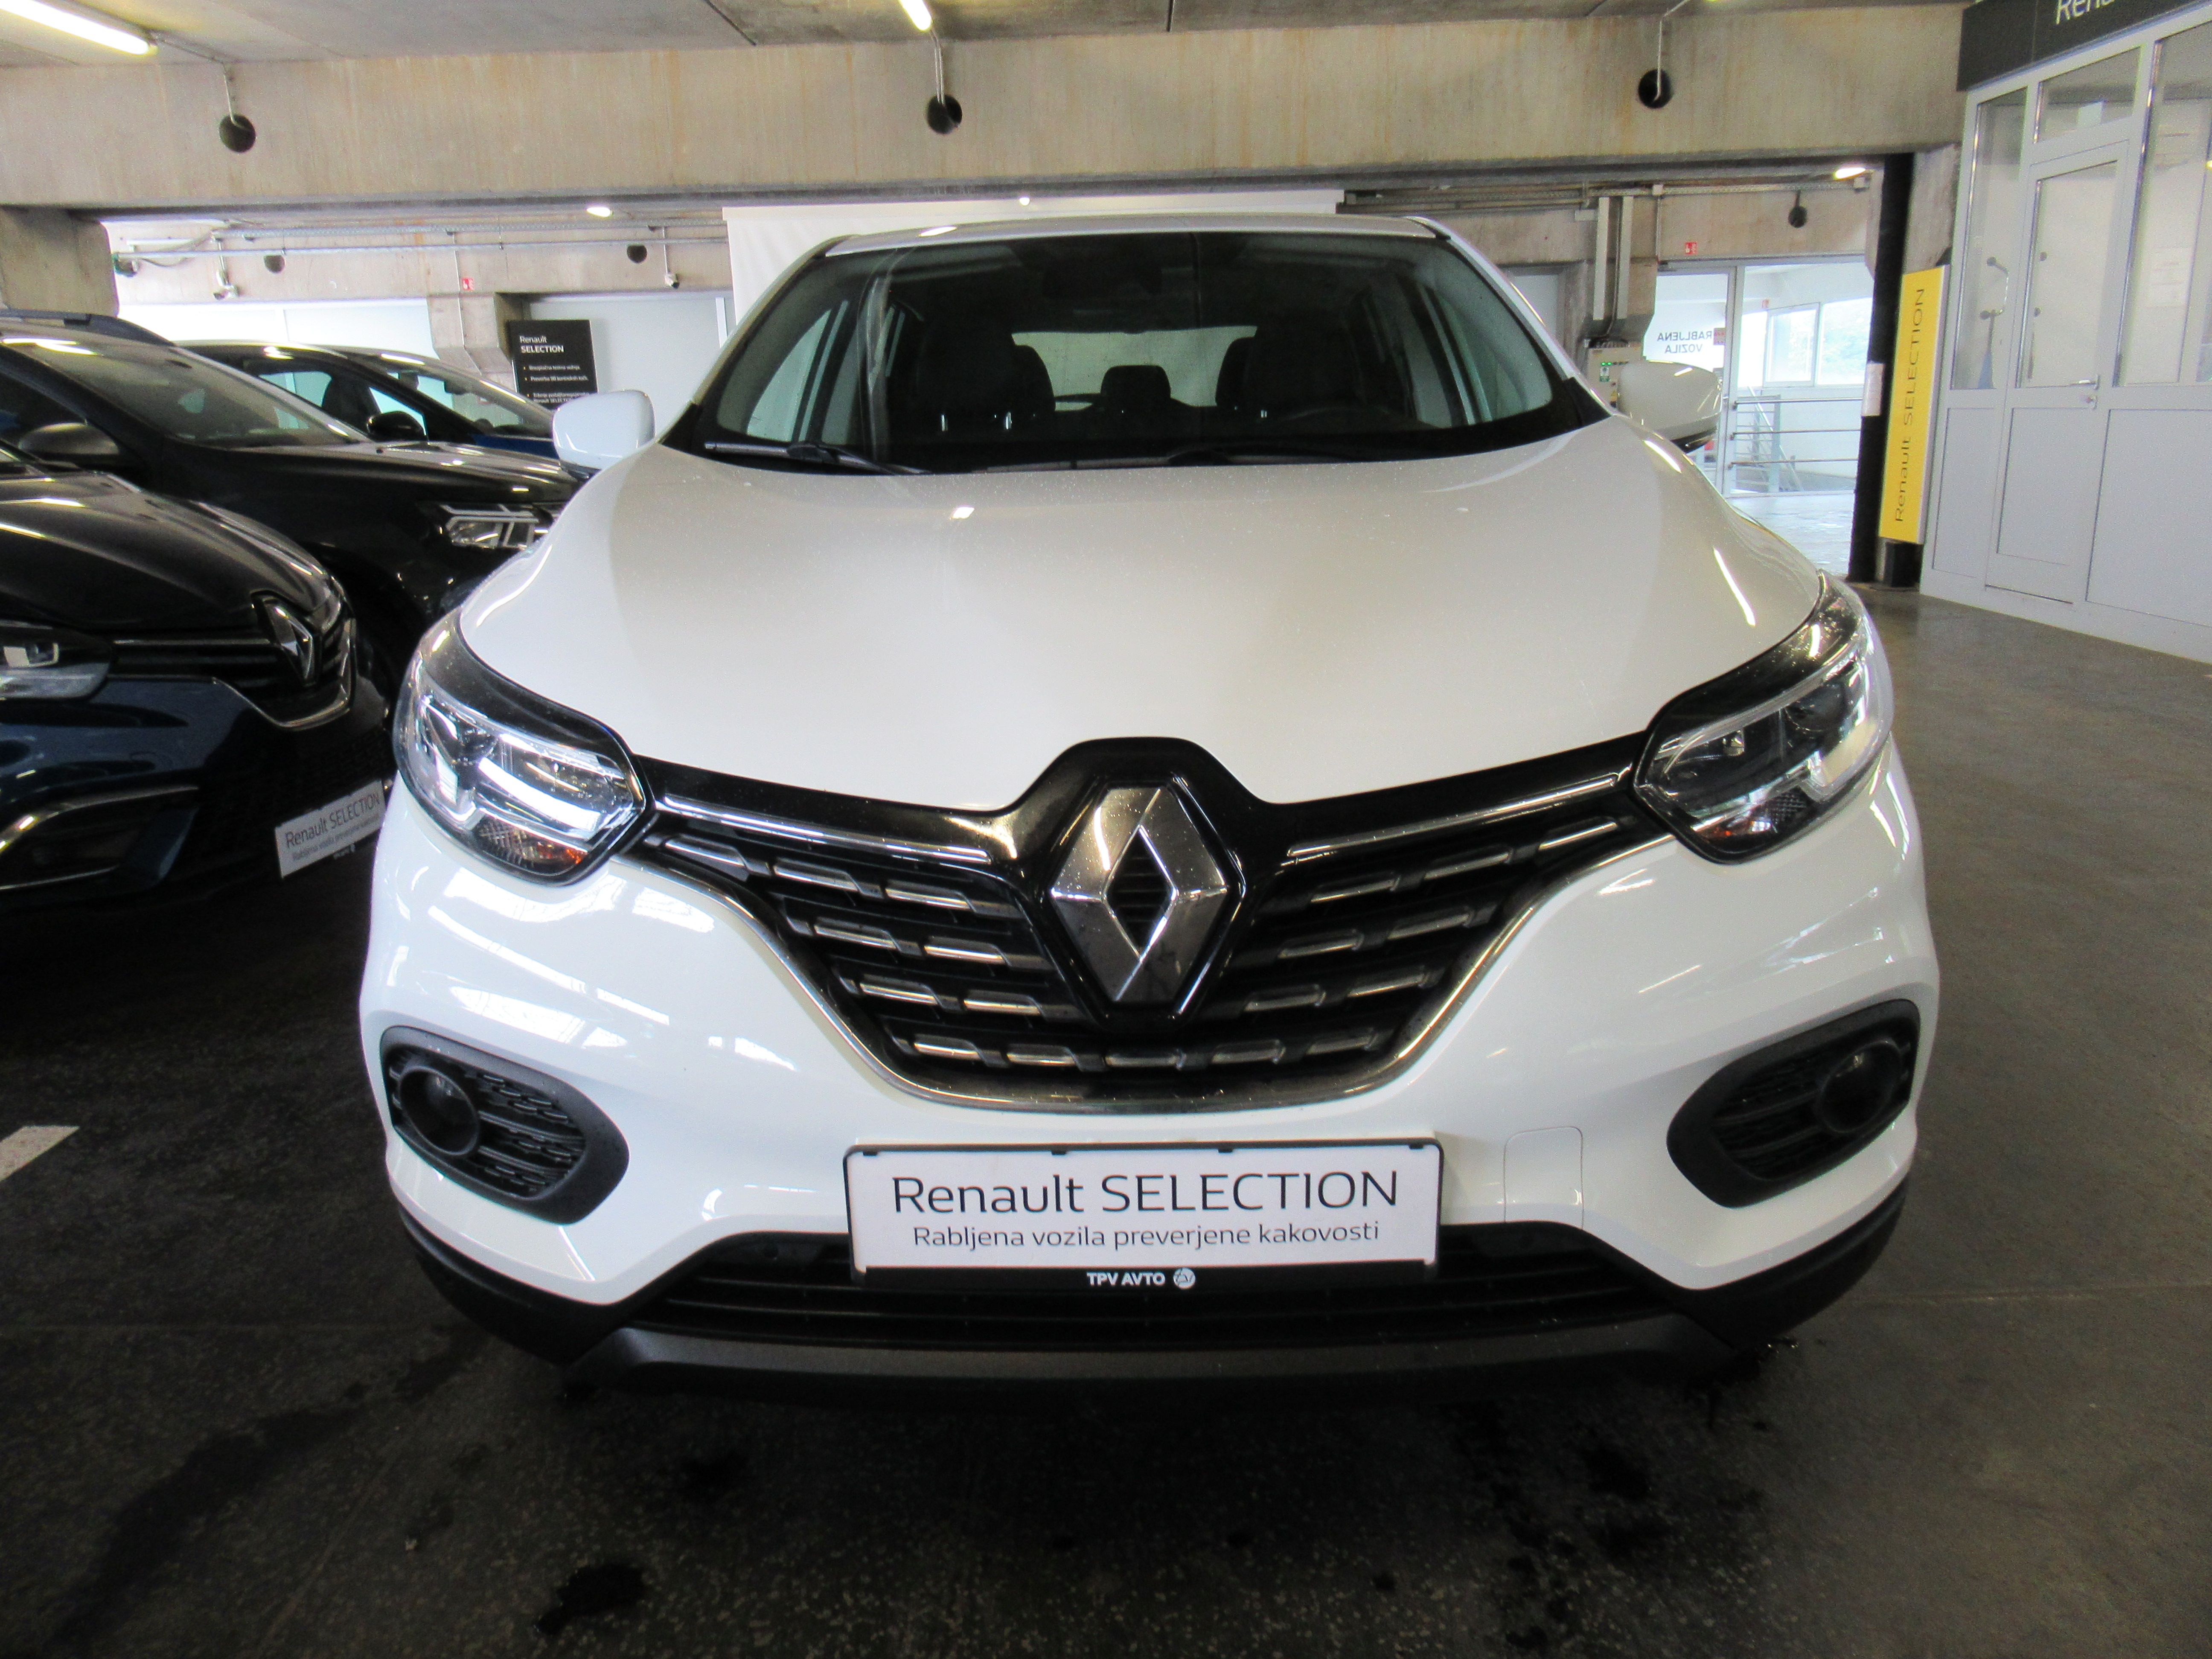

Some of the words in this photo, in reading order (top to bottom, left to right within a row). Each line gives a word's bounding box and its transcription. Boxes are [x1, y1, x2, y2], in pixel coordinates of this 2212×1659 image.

[519, 335, 547, 343] Renault
[521, 345, 565, 353] SELECTION
[1895, 437, 1911, 521] Renault
[1903, 288, 1925, 426] SELECTION
[285, 817, 327, 848] Renault
[329, 792, 381, 829] SELECTION
[892, 1174, 1085, 1213] Renault
[1101, 1170, 1397, 1212] SELECTION
[913, 1226, 1025, 1251] Rabljena
[1032, 1226, 1106, 1246] vozila
[1114, 1225, 1251, 1251] preverjene
[1258, 1220, 1380, 1244] kakovosti
[1086, 1271, 1119, 1286] TPV
[1121, 1271, 1166, 1286] AVTO
